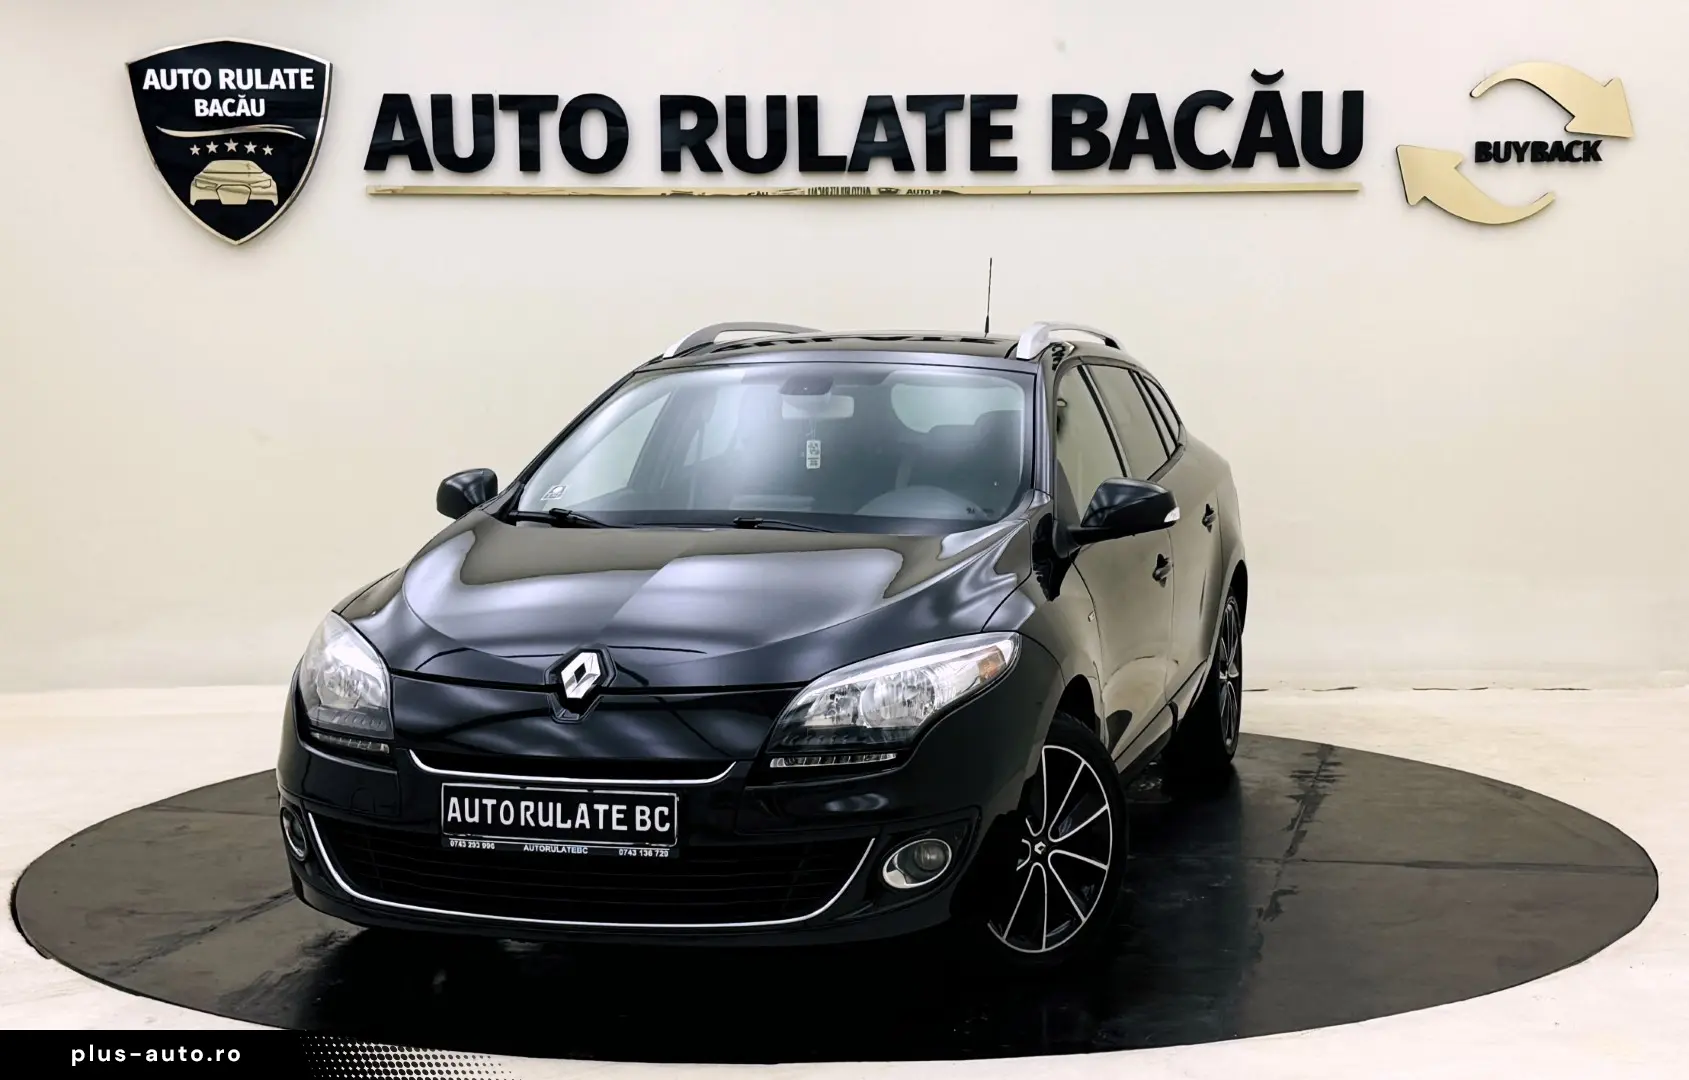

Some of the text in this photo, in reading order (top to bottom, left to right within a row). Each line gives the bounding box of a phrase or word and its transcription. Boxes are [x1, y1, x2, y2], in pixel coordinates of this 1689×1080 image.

[143, 68, 315, 91] AUTO RULATE
[194, 94, 266, 117] BACĂU
[364, 69, 1365, 175] AUTO RULATE BACĂU
[1474, 139, 1603, 164] BUYBACK
[447, 797, 671, 832] AUTO RULATE BC
[523, 844, 589, 855] AUTORULATEBC
